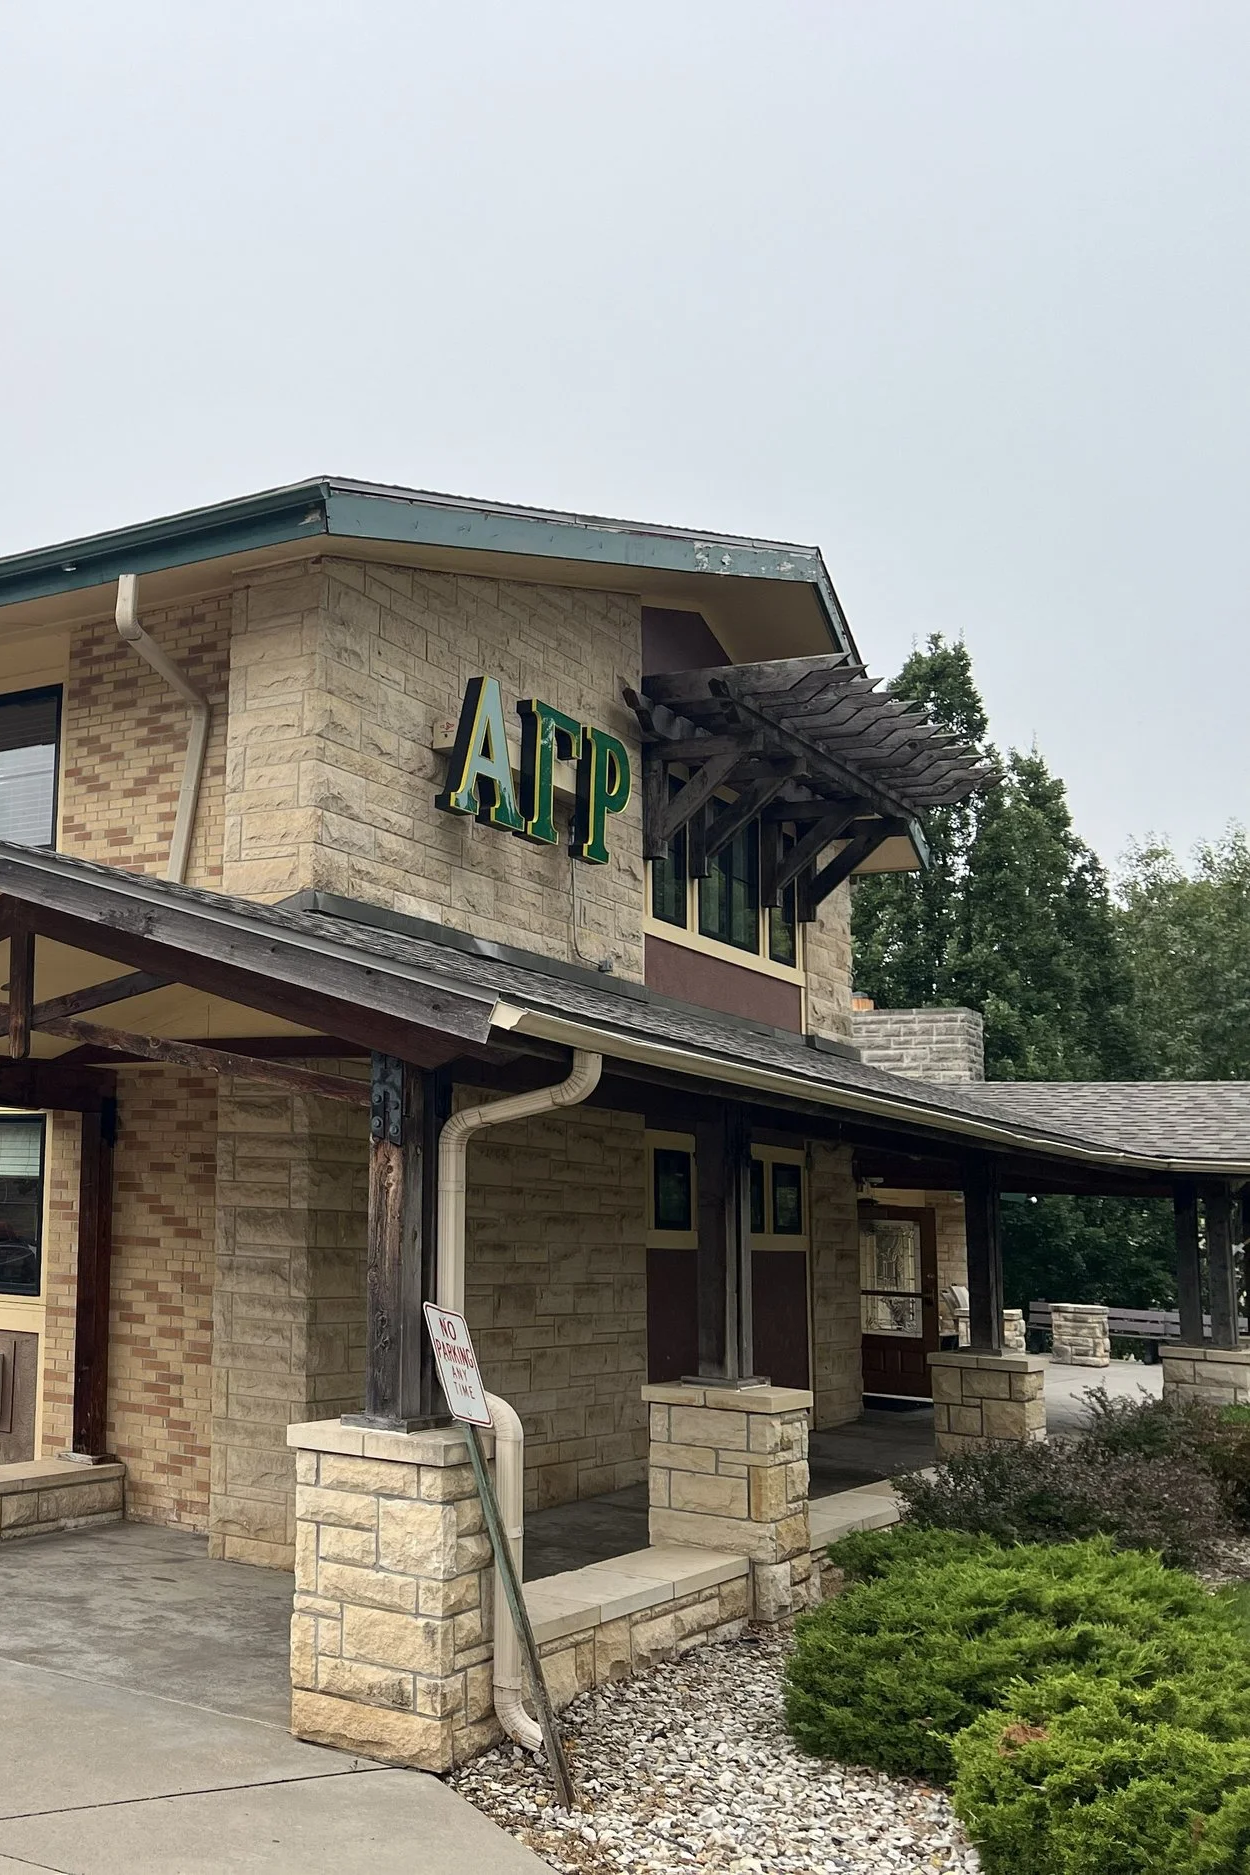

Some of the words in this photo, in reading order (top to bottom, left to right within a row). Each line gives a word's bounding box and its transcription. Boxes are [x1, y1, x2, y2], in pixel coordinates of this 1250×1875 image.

[439, 1317, 457, 1341] NO
[435, 1338, 474, 1370] PARKING
[451, 1365, 468, 1382] ANY
[453, 1381, 476, 1400] TIME
